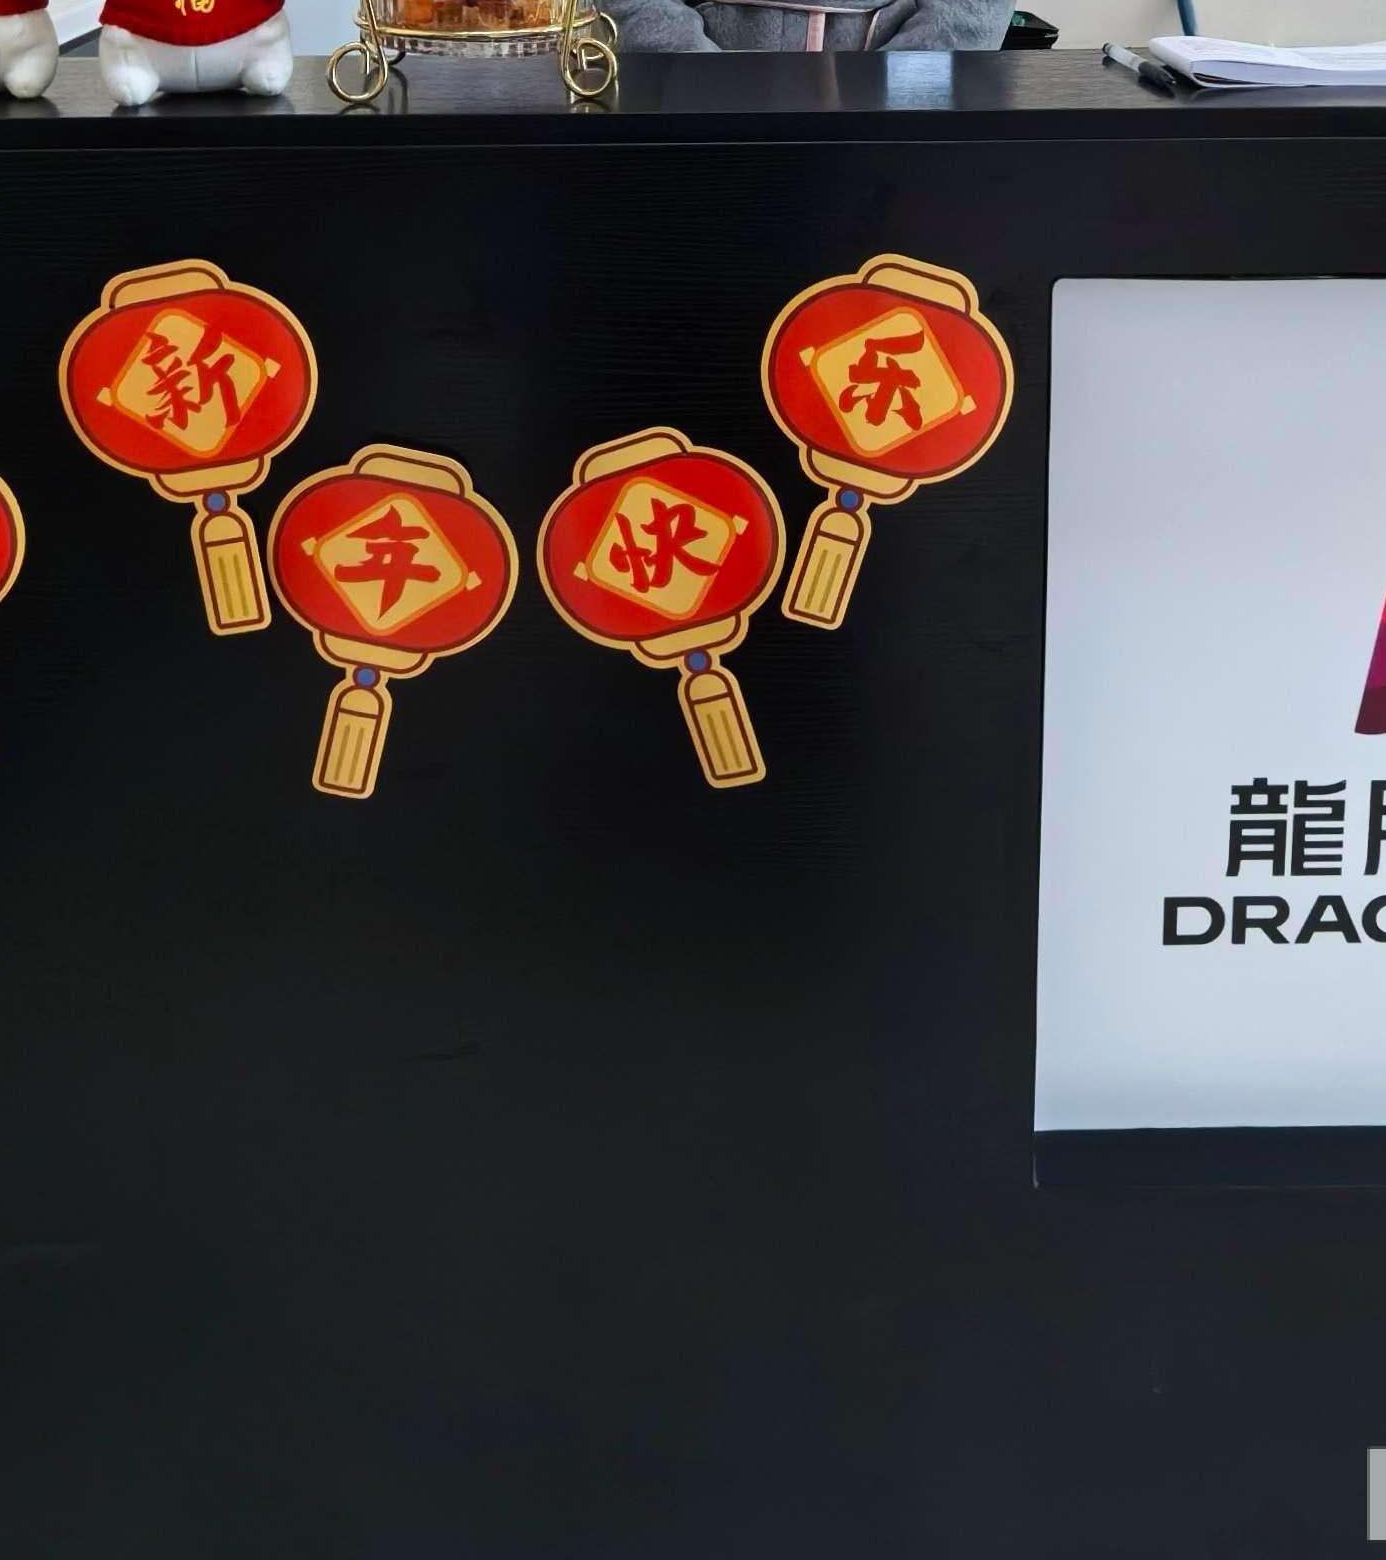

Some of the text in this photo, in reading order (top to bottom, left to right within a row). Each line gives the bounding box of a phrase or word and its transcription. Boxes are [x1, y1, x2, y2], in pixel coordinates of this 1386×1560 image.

[142, 329, 926, 621] 新 年 快 乐
